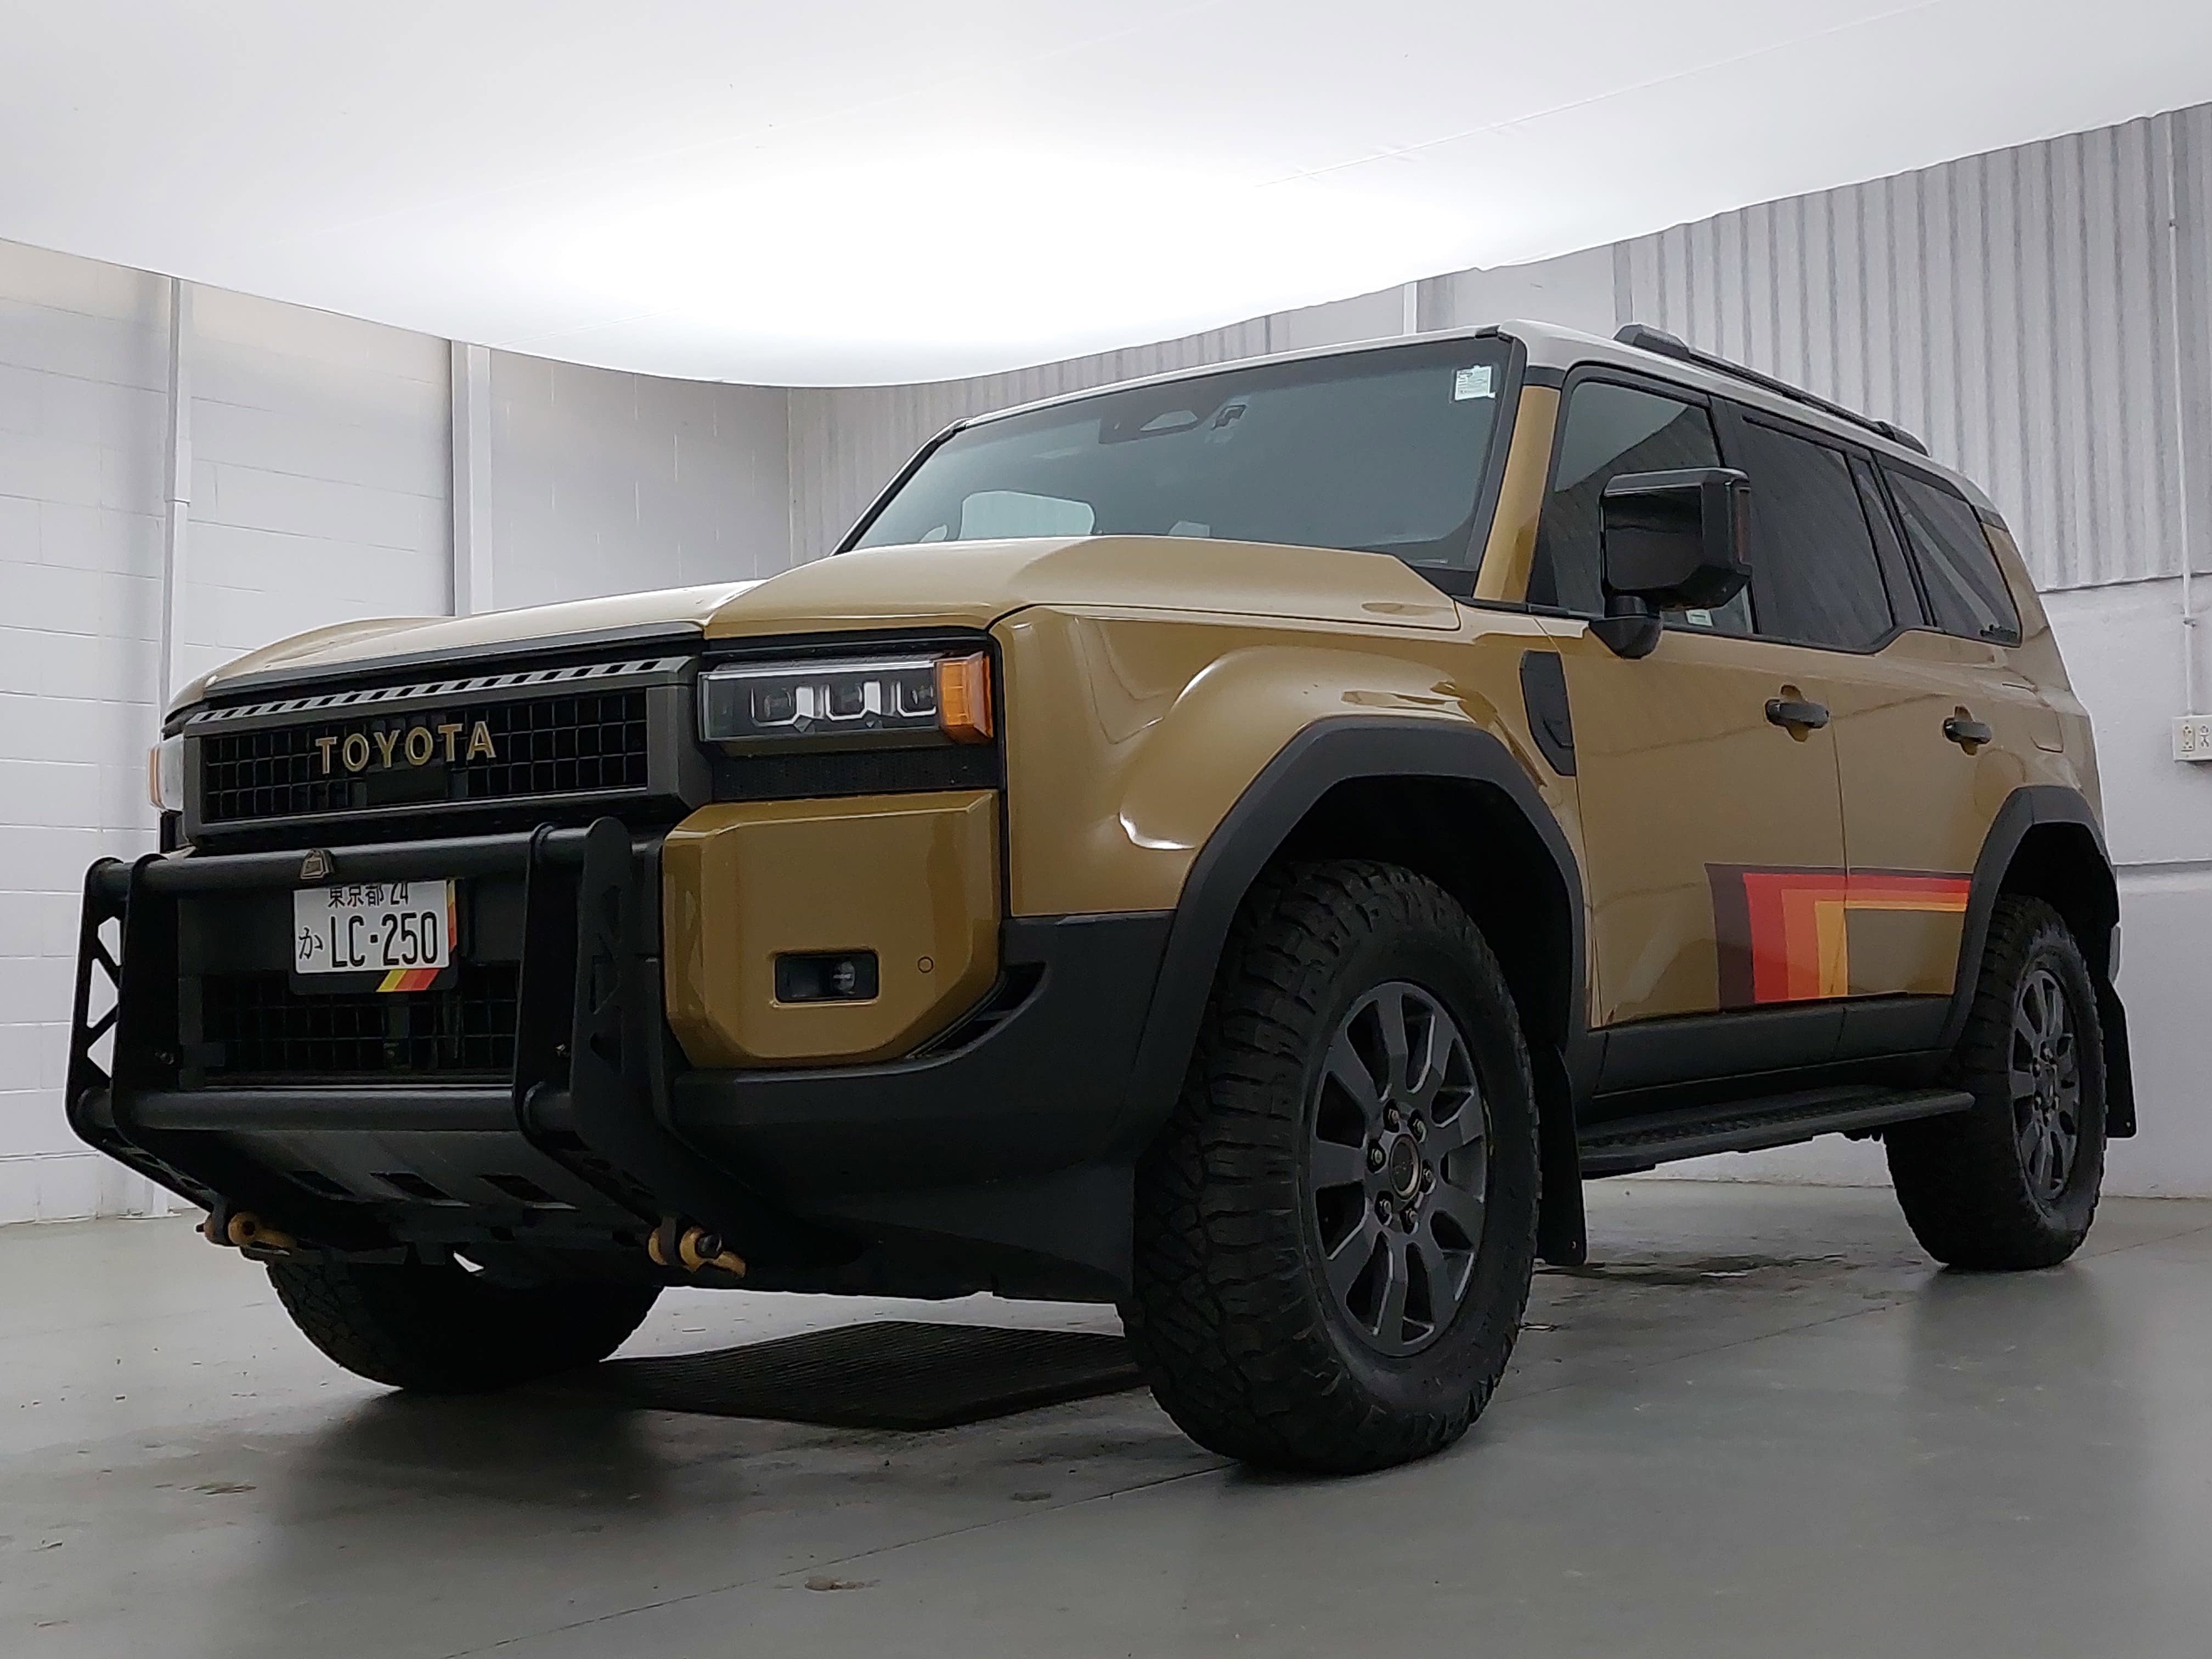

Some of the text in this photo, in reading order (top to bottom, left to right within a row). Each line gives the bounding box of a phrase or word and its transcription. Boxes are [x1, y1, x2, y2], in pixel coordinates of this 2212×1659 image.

[315, 721, 496, 774] TOYOTA
[328, 883, 409, 908] 東京都 24
[298, 927, 323, 959] か
